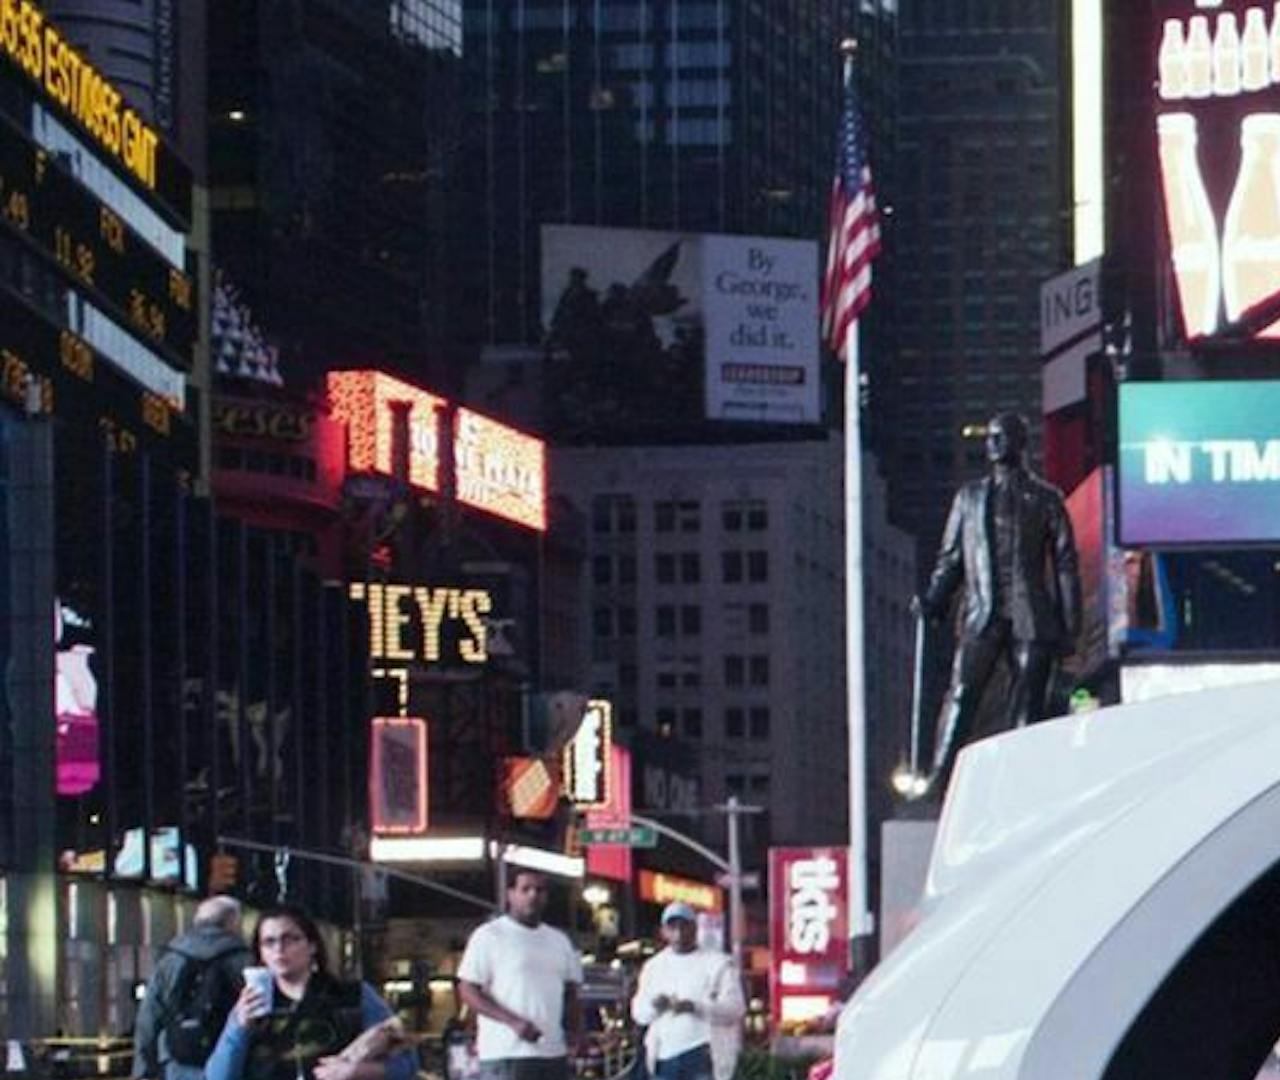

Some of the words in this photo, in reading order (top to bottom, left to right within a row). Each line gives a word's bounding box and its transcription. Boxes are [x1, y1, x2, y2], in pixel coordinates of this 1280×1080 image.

[748, 247, 776, 276] By
[746, 303, 779, 322] we
[729, 322, 768, 348] did
[1144, 441, 1191, 484] IN
